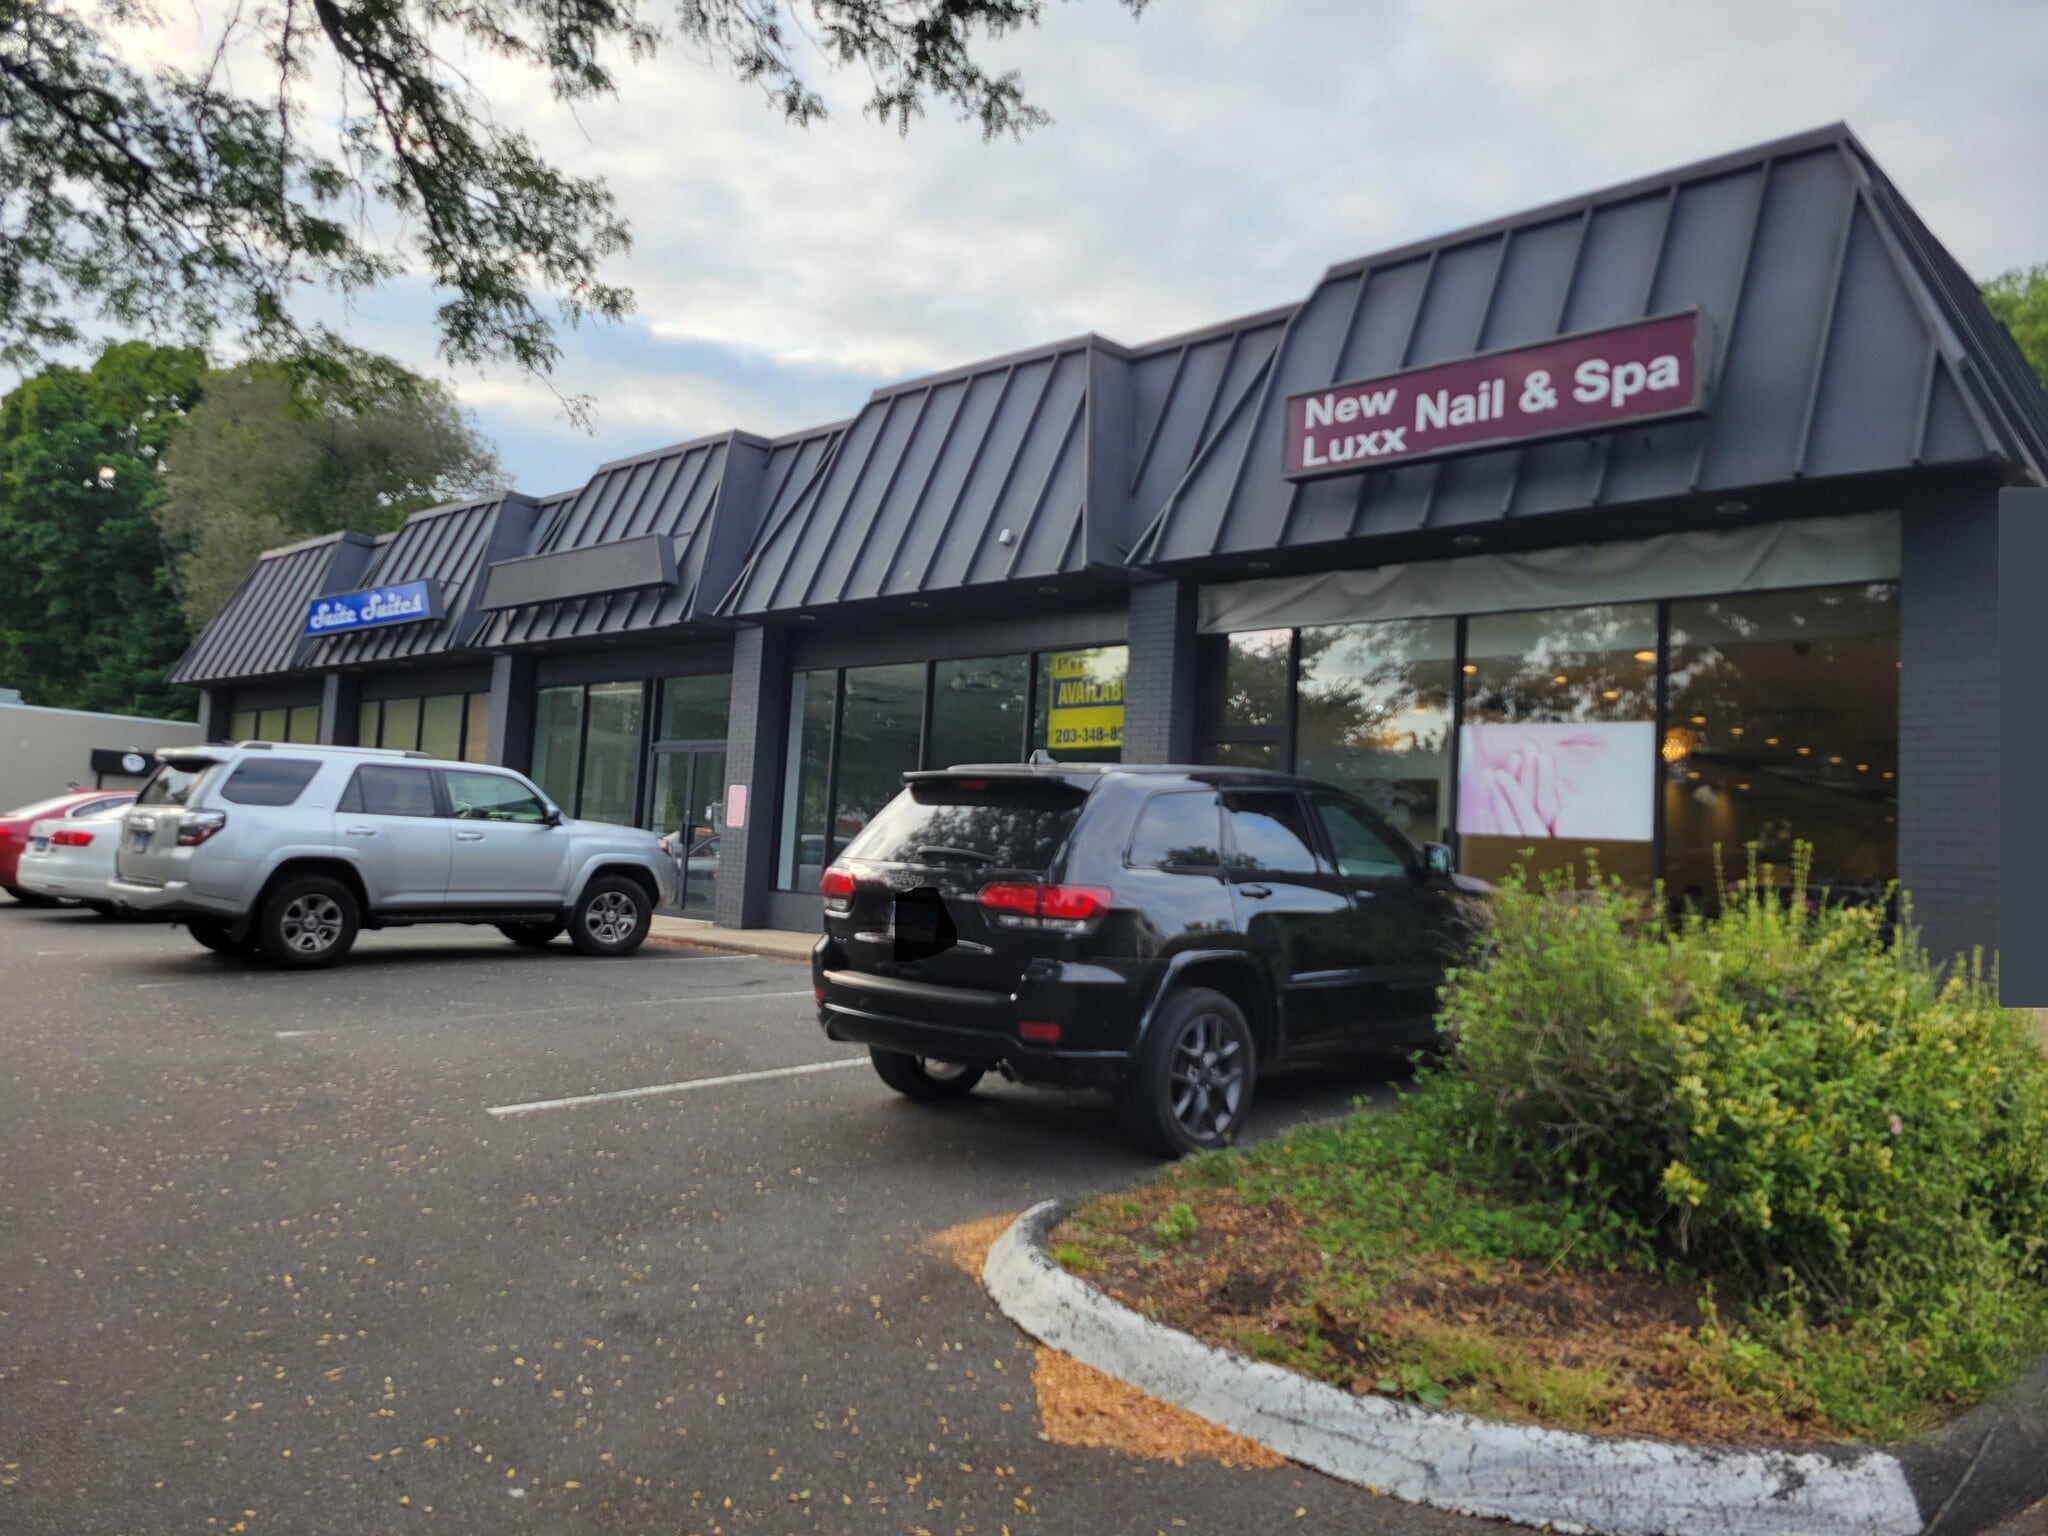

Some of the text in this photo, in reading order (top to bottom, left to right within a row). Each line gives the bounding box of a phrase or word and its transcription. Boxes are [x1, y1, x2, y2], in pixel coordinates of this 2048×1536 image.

[1304, 389, 1398, 429] New
[1415, 354, 1680, 432] Nail & Spa
[1303, 426, 1407, 467] Luxx
